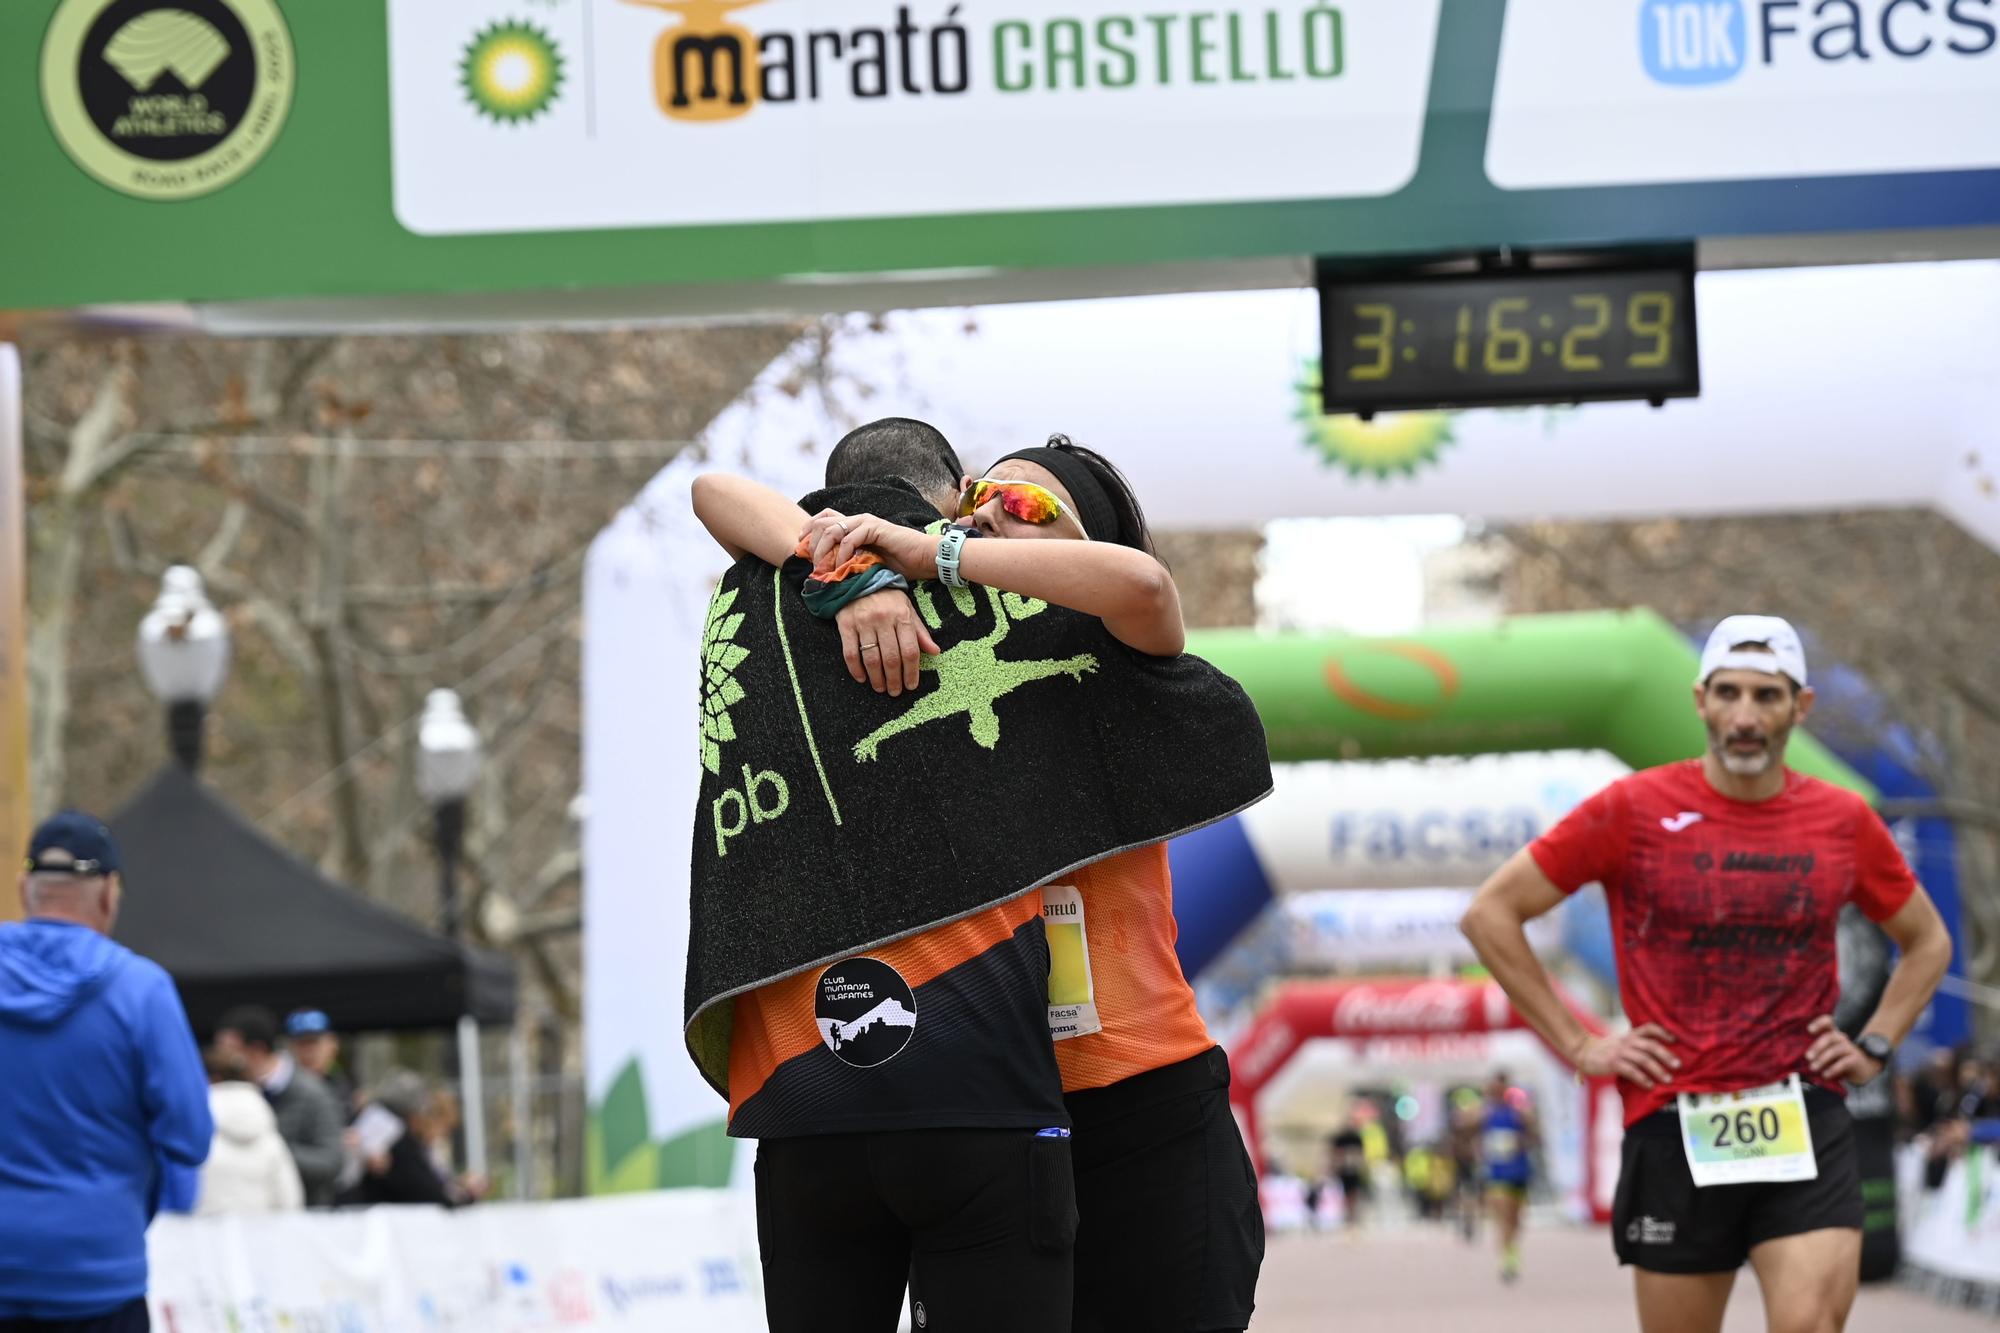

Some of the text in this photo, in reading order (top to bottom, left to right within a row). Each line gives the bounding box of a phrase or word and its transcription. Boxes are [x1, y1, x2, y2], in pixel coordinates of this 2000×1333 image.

[1652, 1, 1738, 71] 10K
[671, 3, 968, 107] marató
[823, 976, 845, 985] CLUB
[824, 983, 870, 993] MUNTANYA
[826, 991, 874, 1001] VILAFAMES
[1709, 1107, 1779, 1148] 260
